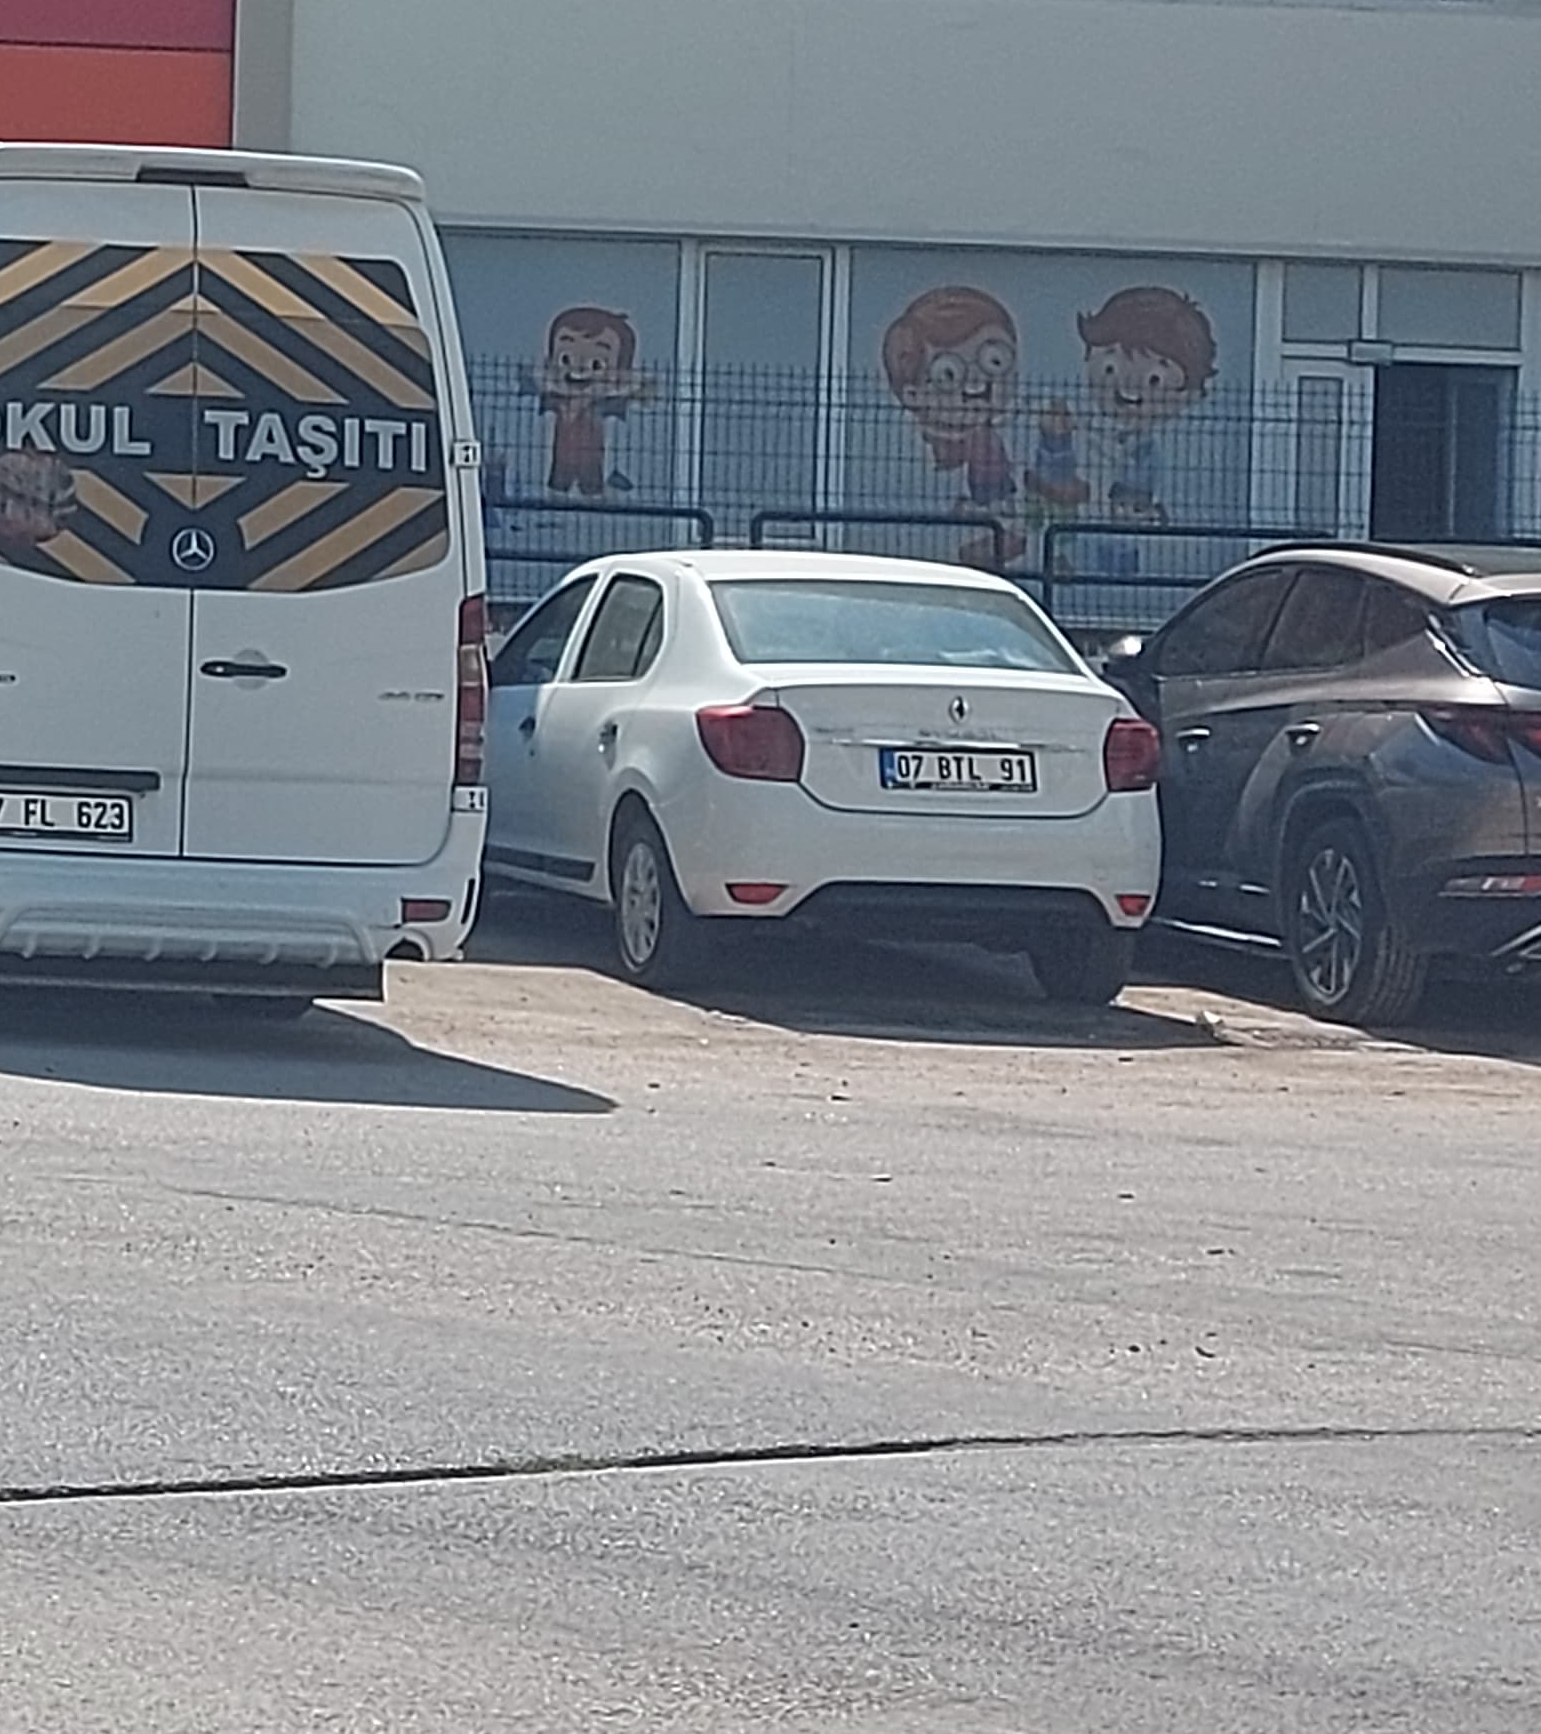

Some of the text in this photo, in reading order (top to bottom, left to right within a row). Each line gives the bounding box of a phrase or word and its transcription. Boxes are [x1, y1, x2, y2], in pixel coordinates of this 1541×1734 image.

[204, 409, 427, 479] TAŞITI
[898, 755, 1026, 782] 07 BTL 91
[23, 798, 56, 828] FL
[76, 801, 125, 831] 623
